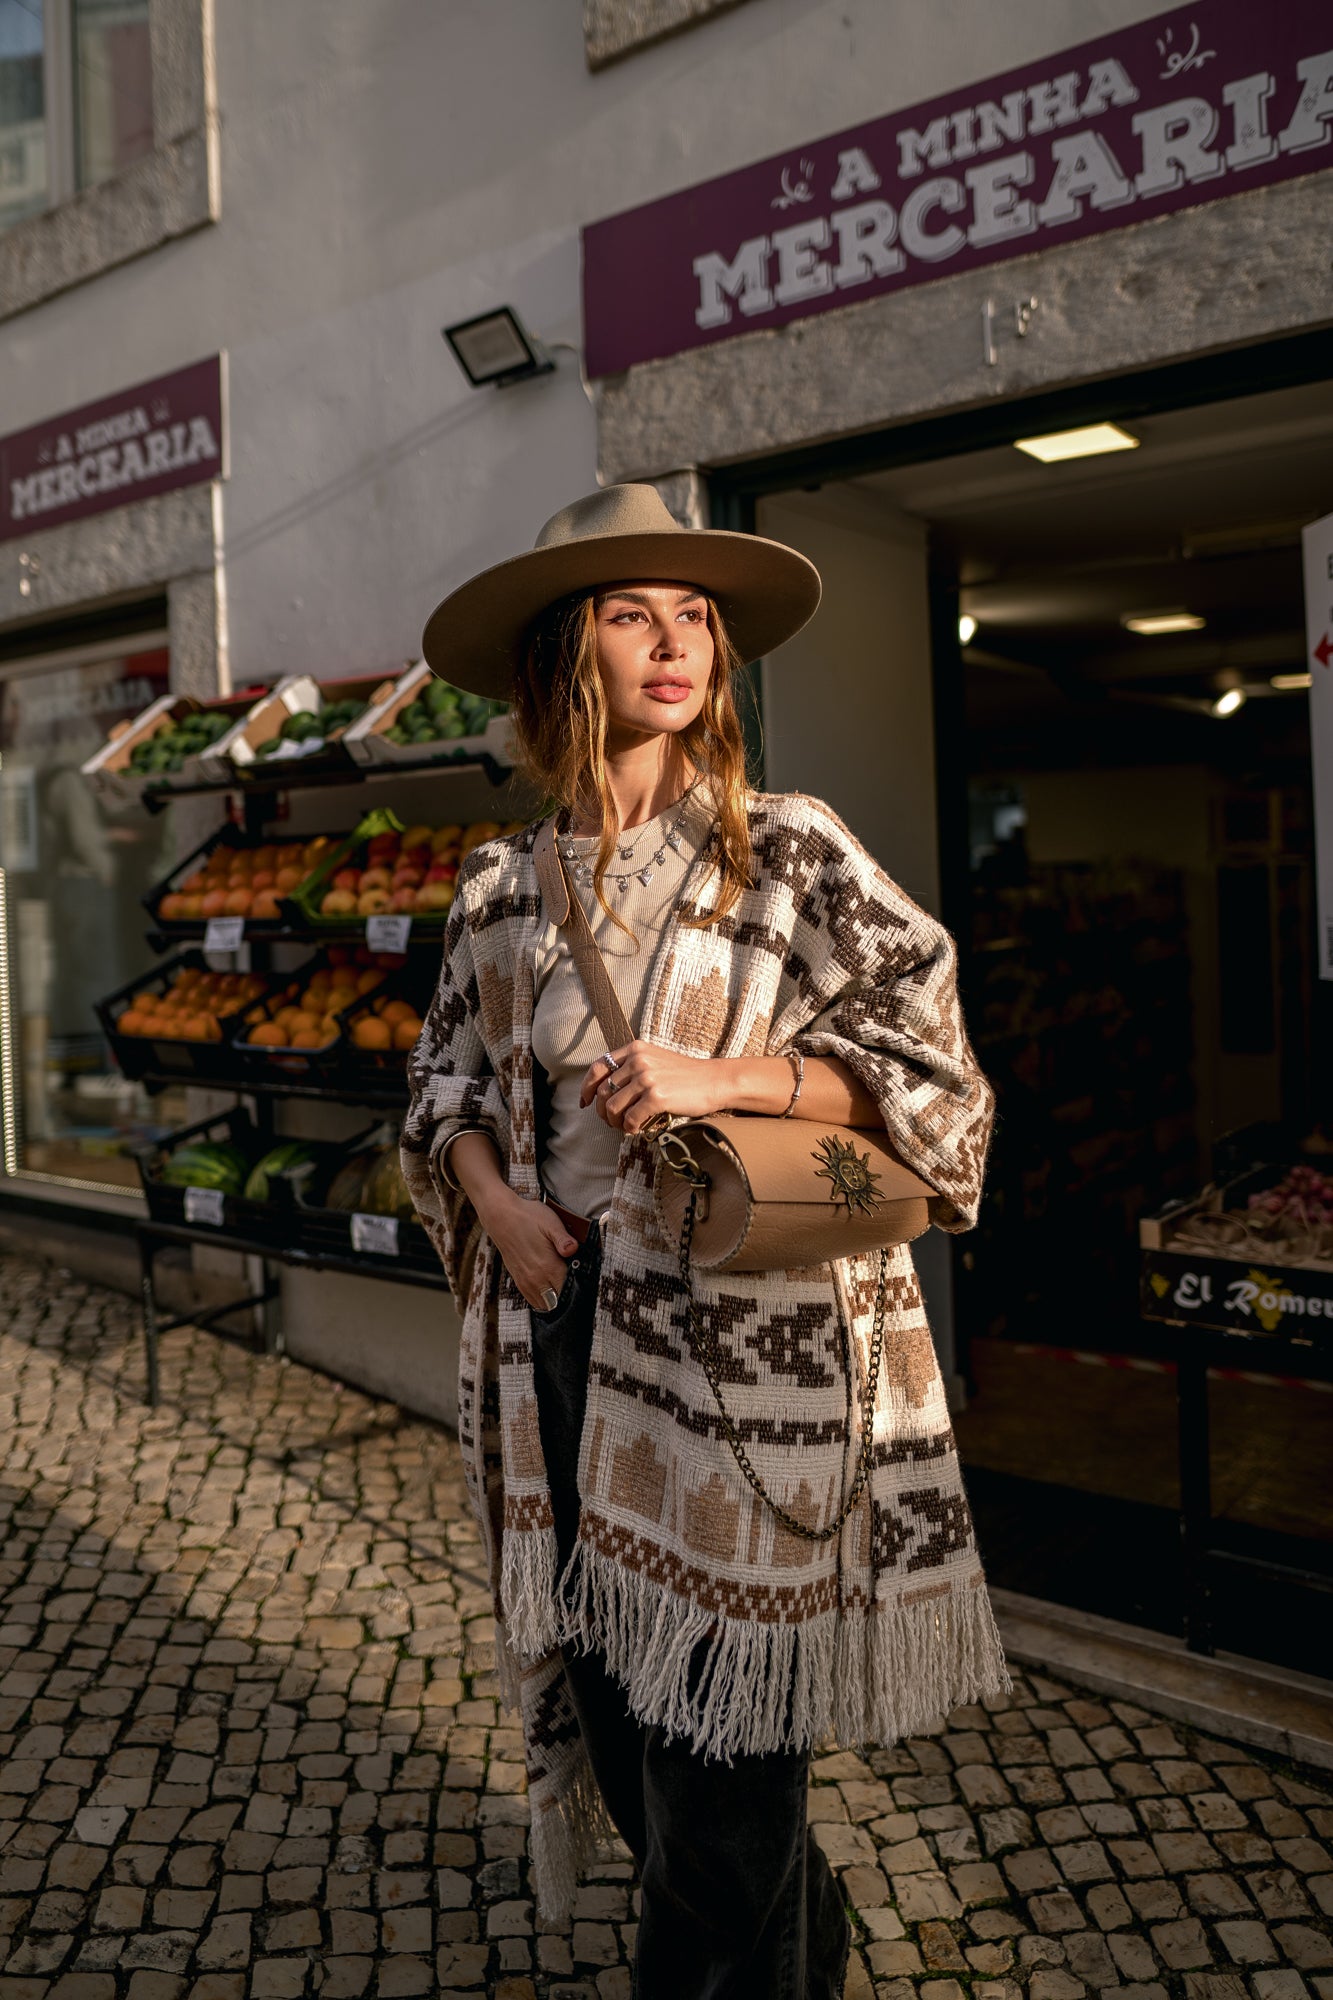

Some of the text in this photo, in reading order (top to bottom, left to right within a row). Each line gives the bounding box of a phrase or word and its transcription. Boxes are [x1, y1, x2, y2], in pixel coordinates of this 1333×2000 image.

[830, 57, 1140, 199] A MINHA
[692, 50, 1333, 330] MERCEARIA
[10, 415, 219, 521] MERCEARIA
[55, 433, 74, 462] A
[1173, 1272, 1213, 1309] El
